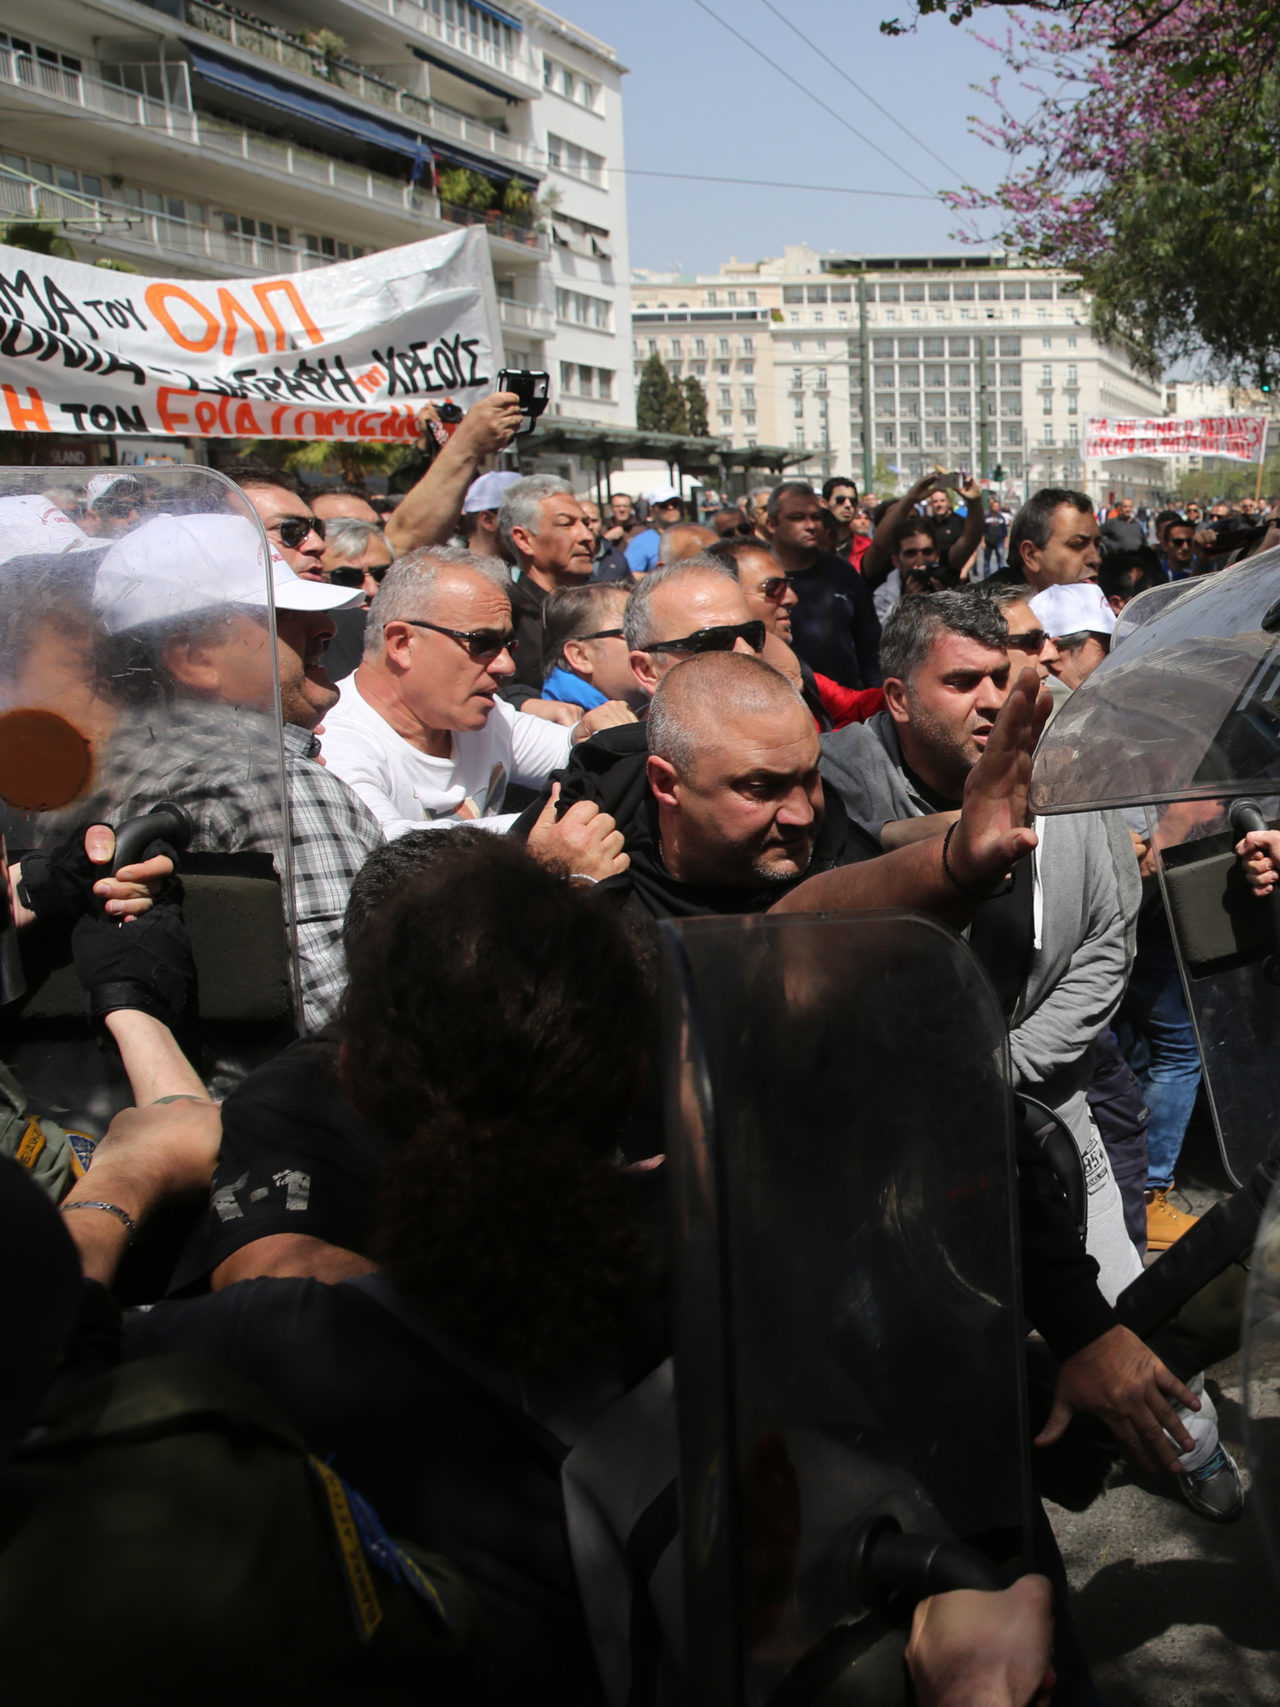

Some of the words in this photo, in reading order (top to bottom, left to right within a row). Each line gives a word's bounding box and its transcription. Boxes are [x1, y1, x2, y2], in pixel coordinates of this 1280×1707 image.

[0, 269, 99, 340] ΜΑ
[83, 298, 148, 331] ΤΟΥ
[144, 280, 325, 356] ΟΛΠ
[0, 315, 146, 386] ΟΝΙΑ
[354, 364, 388, 394] ΤΟΥ
[371, 333, 489, 397] ΧΡΕΟΥΣ
[1, 383, 53, 433] Η
[60, 403, 151, 433] ΤΟΝ
